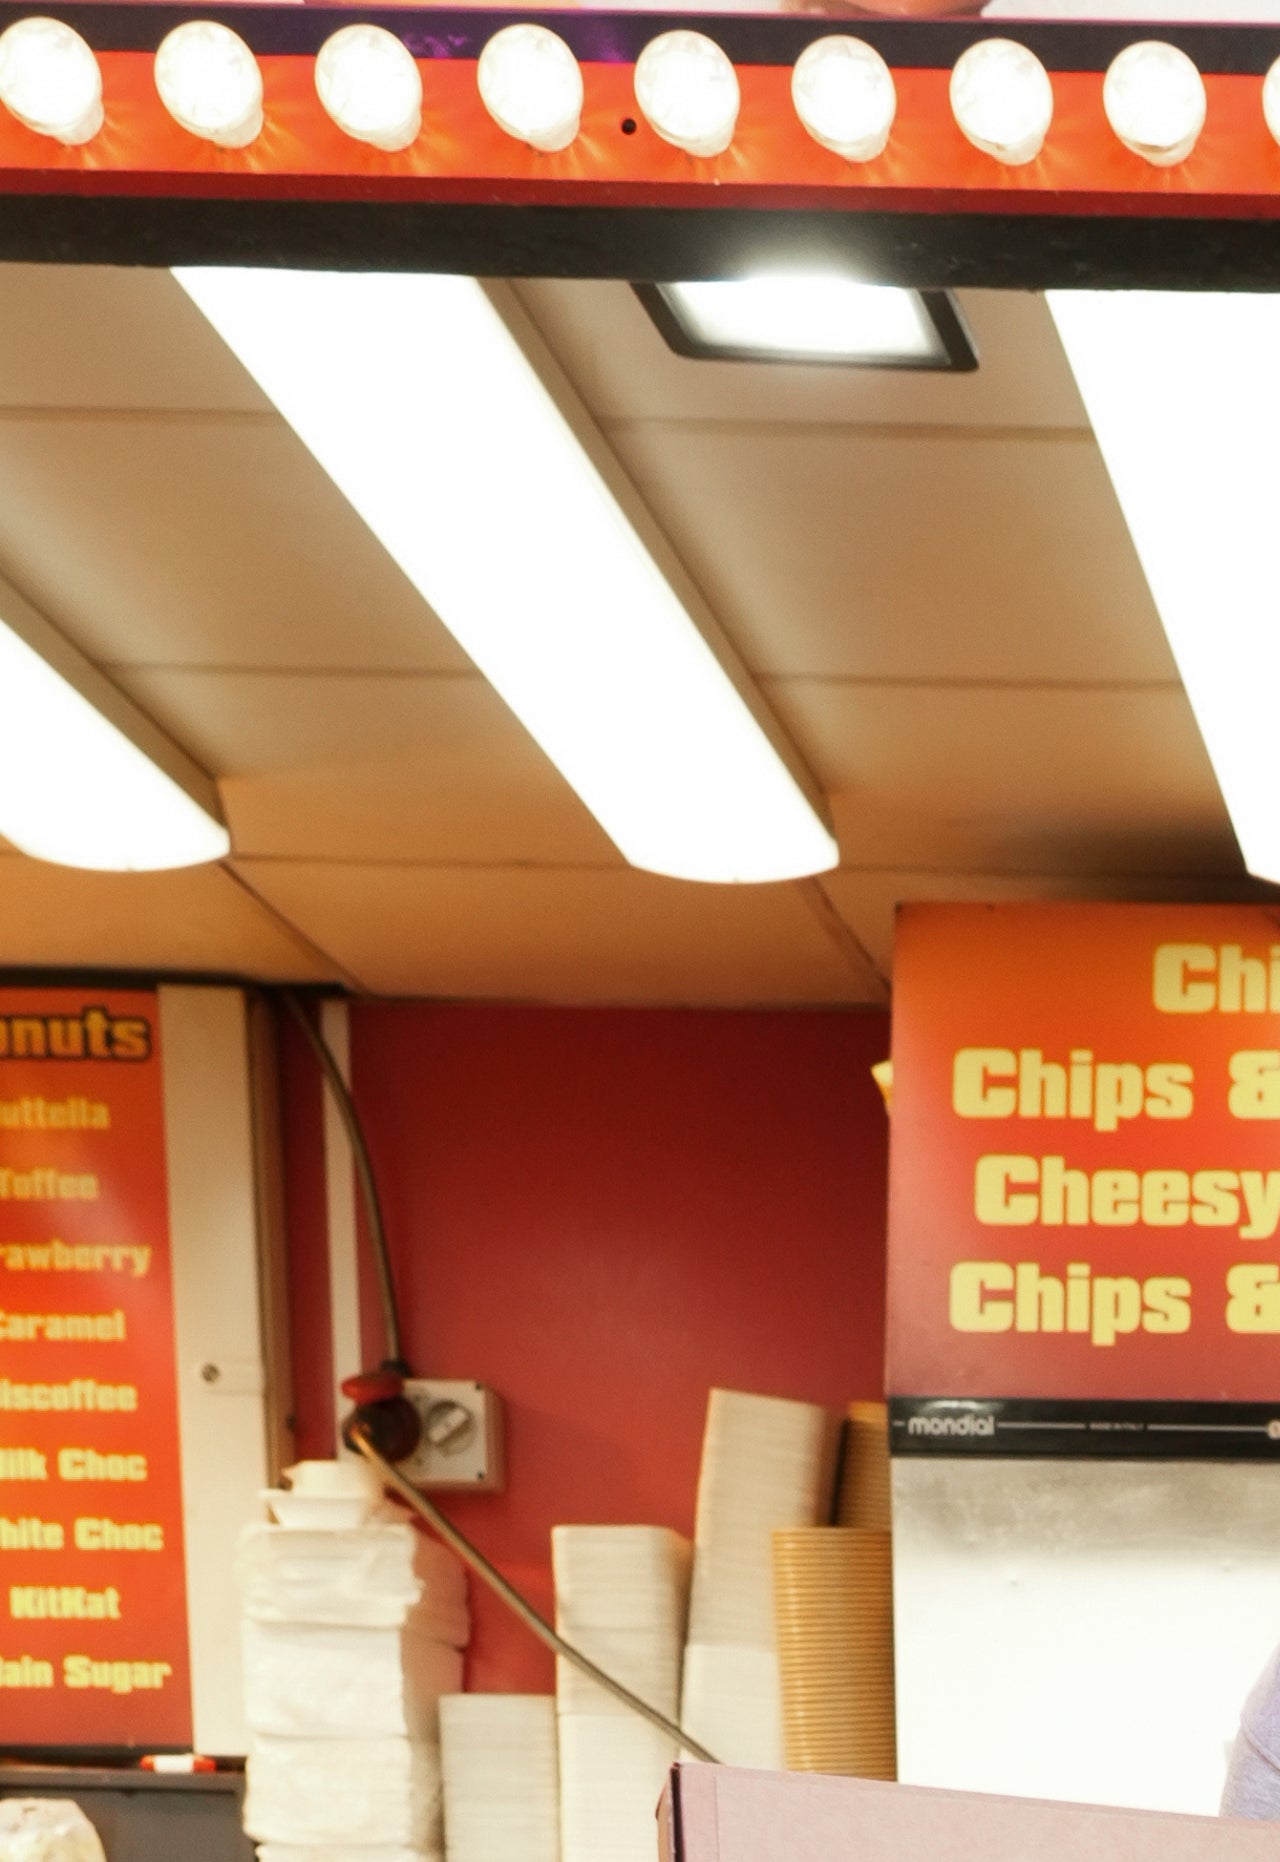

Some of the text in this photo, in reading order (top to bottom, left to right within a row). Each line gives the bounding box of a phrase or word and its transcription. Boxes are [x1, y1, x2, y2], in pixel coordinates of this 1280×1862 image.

[952, 1048, 1194, 1132] Chips
[950, 1261, 1192, 1346] Chips
[907, 1414, 995, 1437] mondial
[59, 1448, 147, 1480] Choc
[74, 1517, 164, 1550] Choc
[9, 1586, 120, 1619] KitKat
[64, 1655, 172, 1693] Sugar
